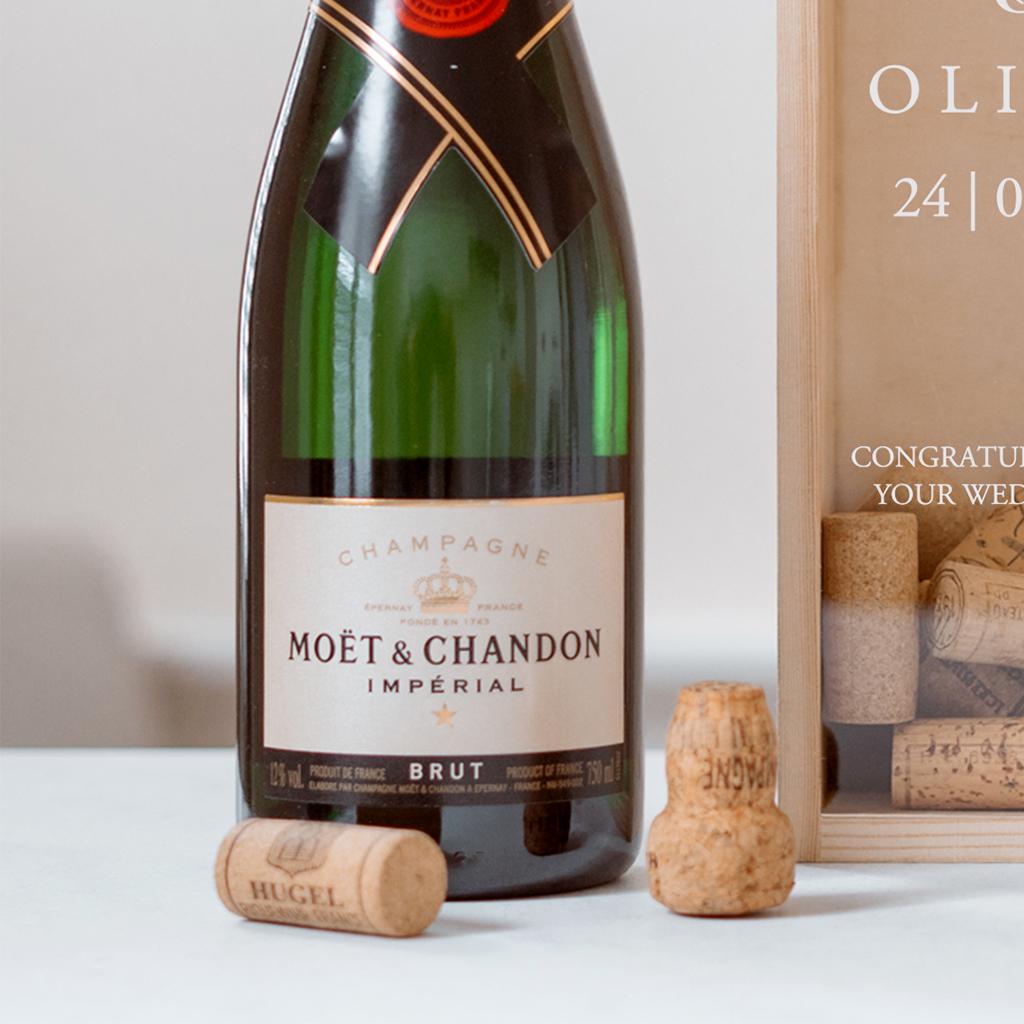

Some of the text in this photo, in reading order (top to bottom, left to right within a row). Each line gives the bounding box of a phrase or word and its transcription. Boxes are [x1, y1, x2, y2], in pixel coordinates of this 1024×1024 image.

[874, 483, 956, 505] YOUR
[338, 534, 550, 567] CHAMPAGNE
[443, 617, 459, 626] EN
[287, 627, 601, 666] MOËT & CHANDON
[368, 674, 524, 694] IMPÉRIAL
[354, 767, 386, 781] FRANCE
[409, 762, 484, 780] BRUT
[249, 879, 345, 908] HUGEL
